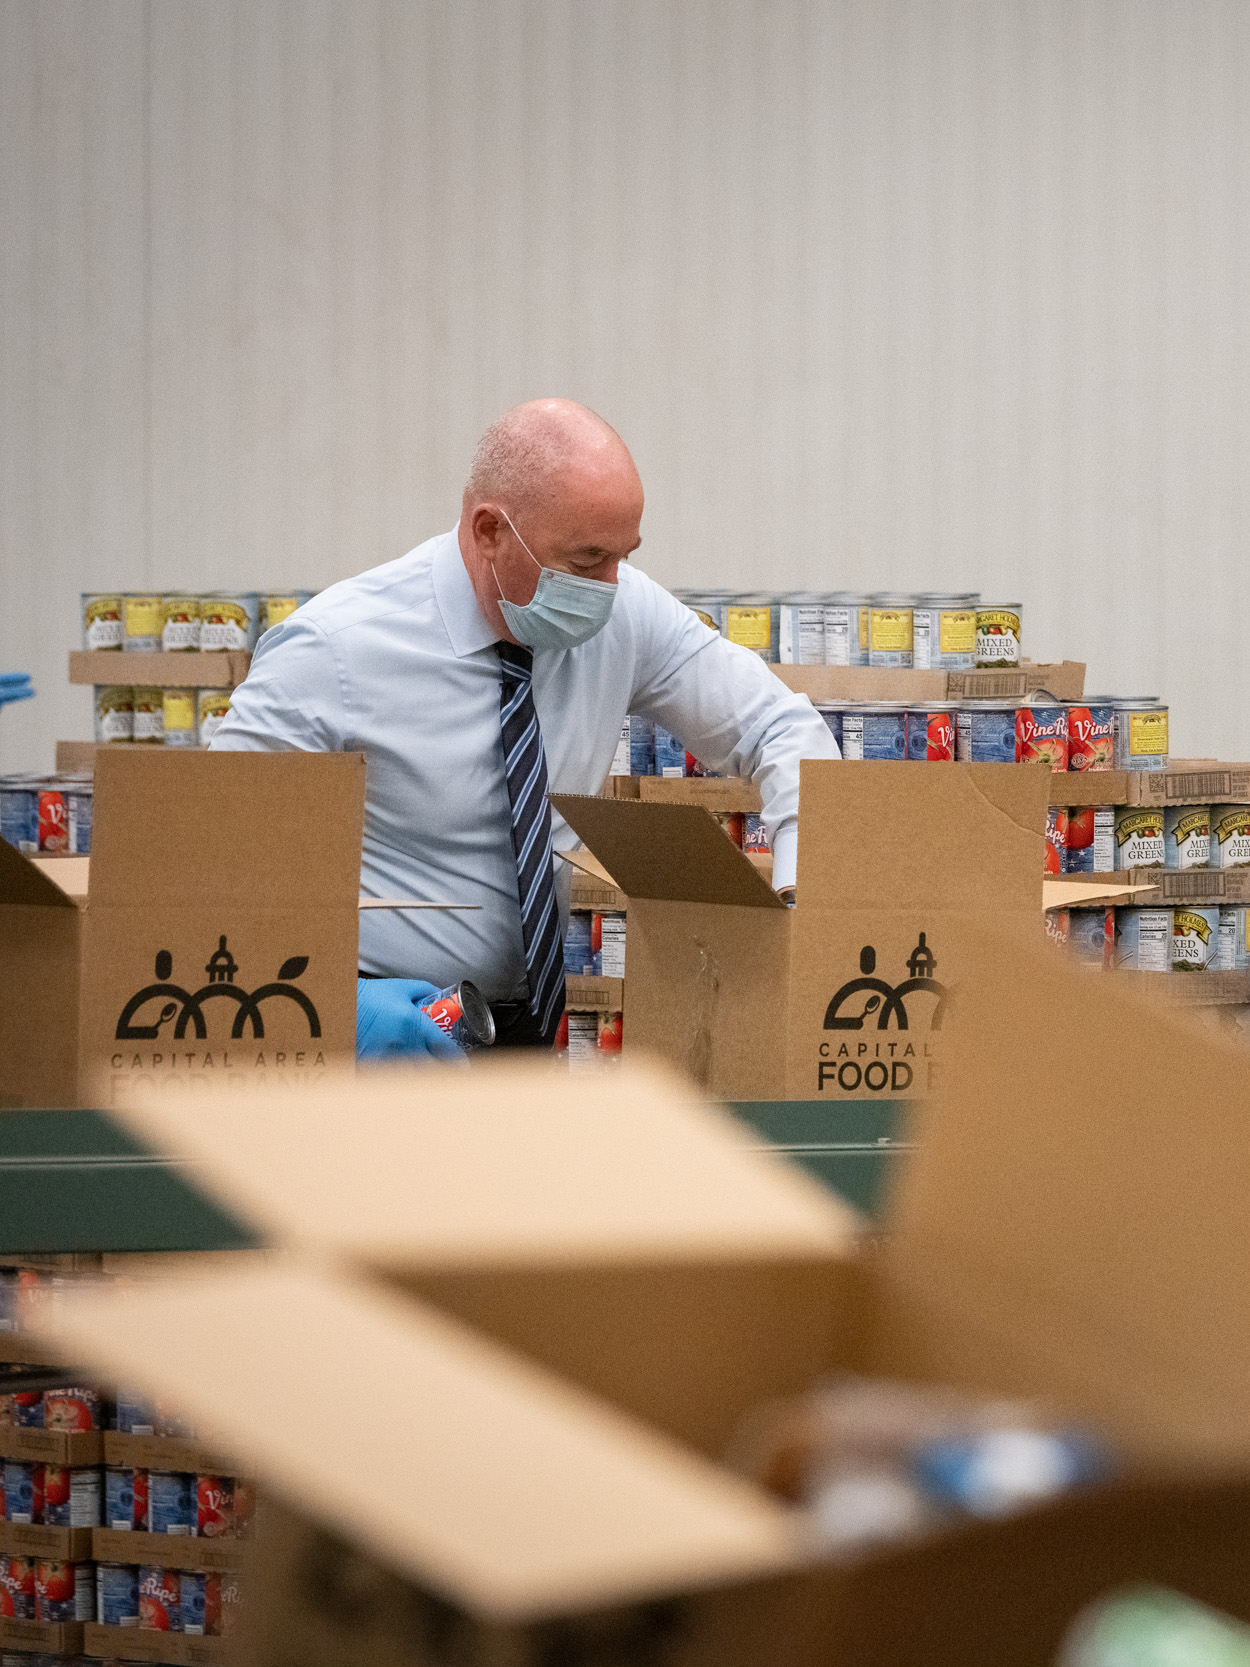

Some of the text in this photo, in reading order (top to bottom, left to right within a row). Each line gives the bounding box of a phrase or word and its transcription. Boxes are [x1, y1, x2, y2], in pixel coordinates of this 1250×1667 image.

[976, 638, 1012, 647] MIXED
[1020, 720, 1056, 743] Vine
[1074, 719, 1109, 742] Vine
[1132, 840, 1163, 851] MIXED
[1181, 914, 1206, 930] HOLMES
[818, 1042, 933, 1058] CAPITAL
[110, 1051, 326, 1070] CAPITAL AREA
[818, 1061, 914, 1092] FOOD
